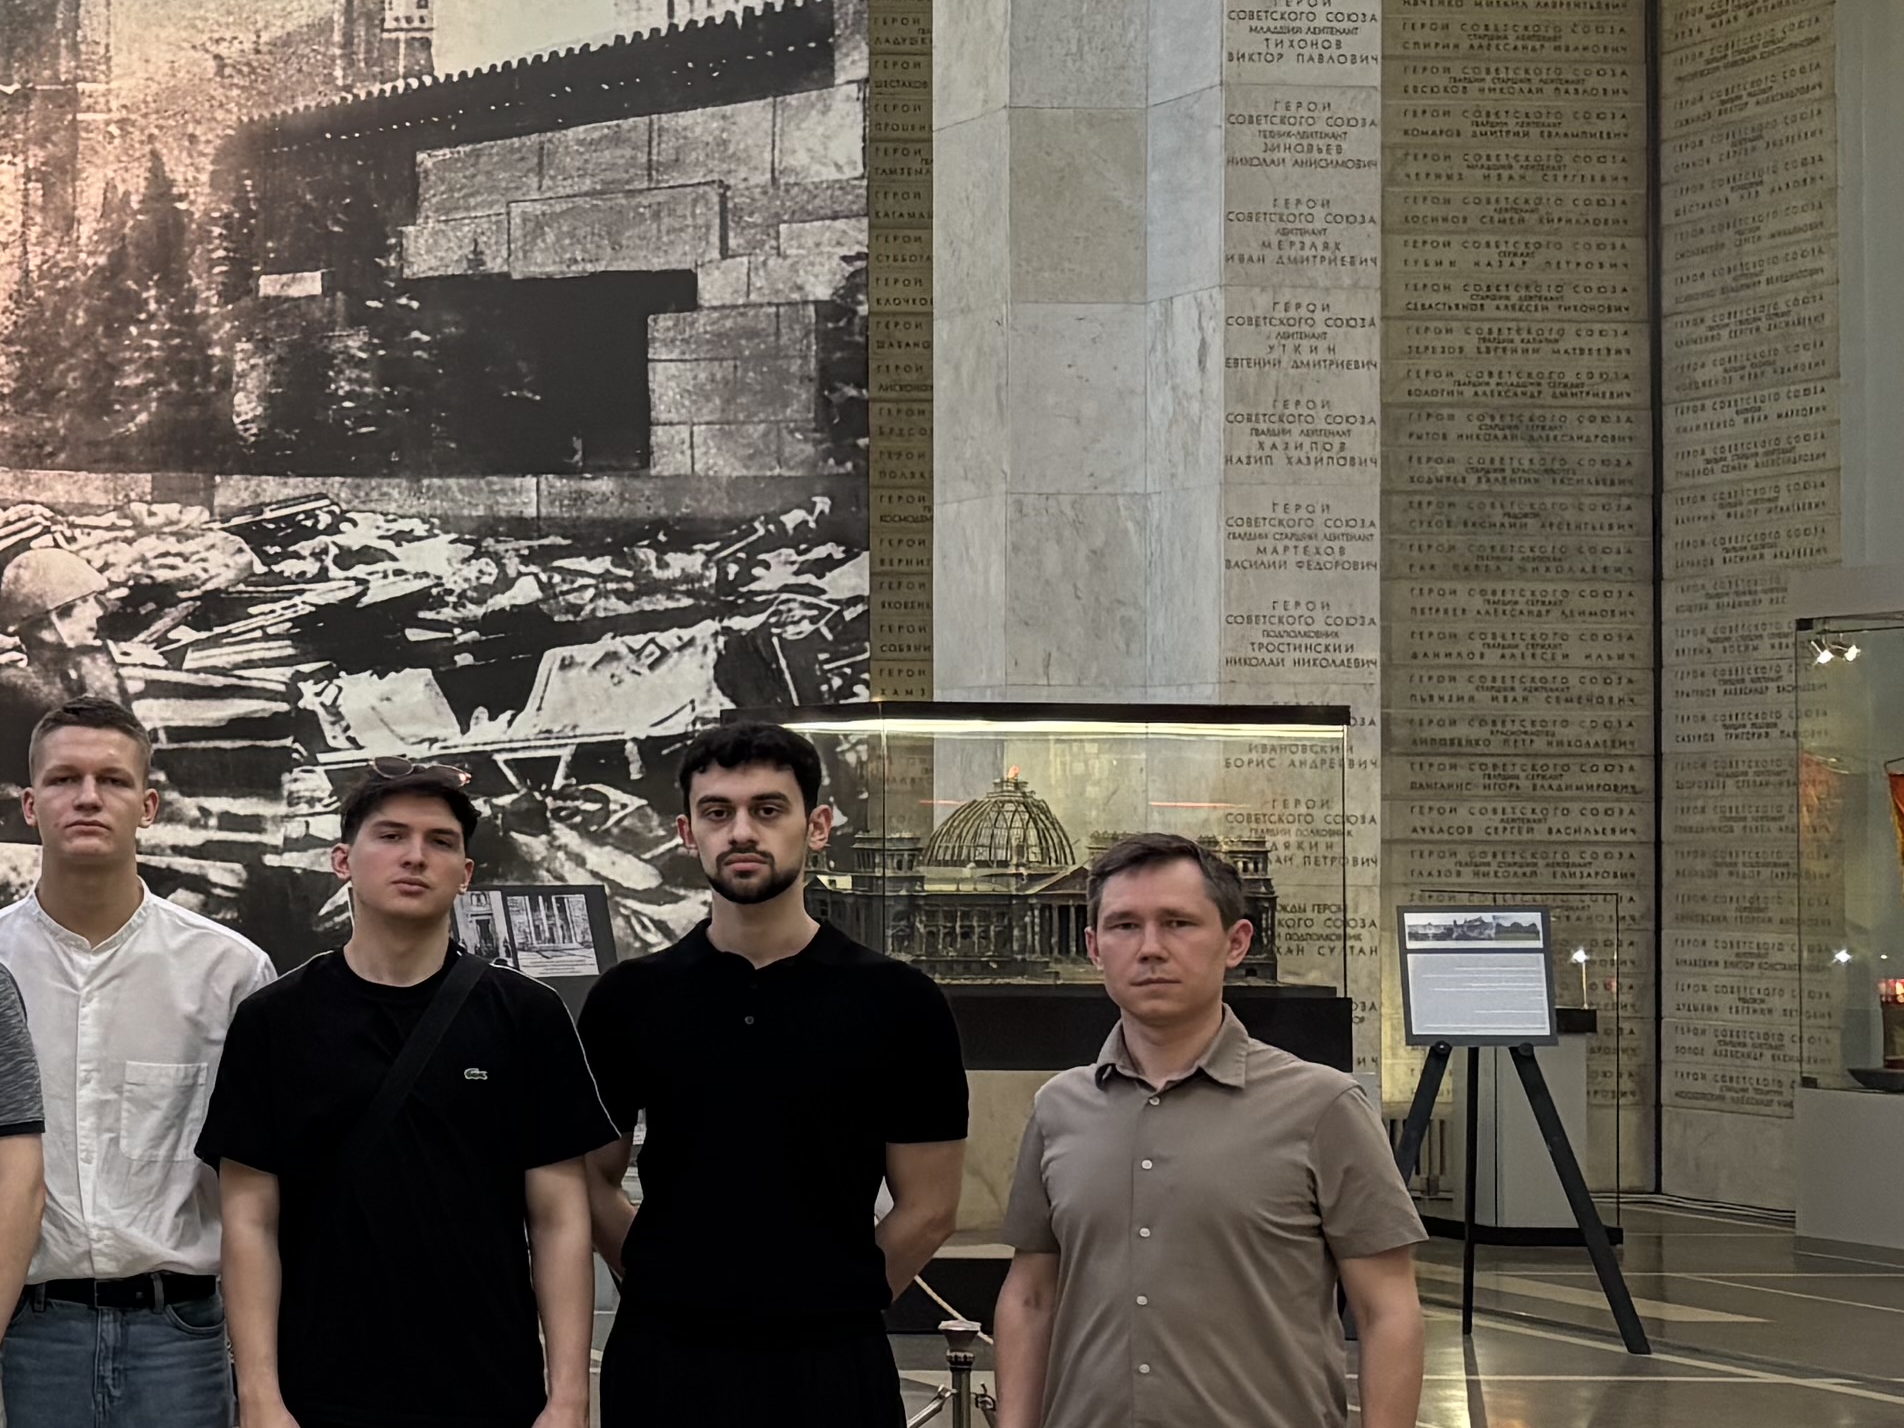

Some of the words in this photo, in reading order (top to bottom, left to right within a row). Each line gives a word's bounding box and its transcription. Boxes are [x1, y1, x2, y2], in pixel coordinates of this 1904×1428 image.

[1227, 9, 1317, 22] СОВЕТСКОГО
[1326, 11, 1378, 23] СОЮЗА
[1263, 38, 1343, 50] ТИХОНОВ
[1227, 51, 1284, 64] ВИКТОР
[1296, 52, 1378, 65] ПАВЛОВИЧ
[1225, 254, 1266, 265] ИВАН
